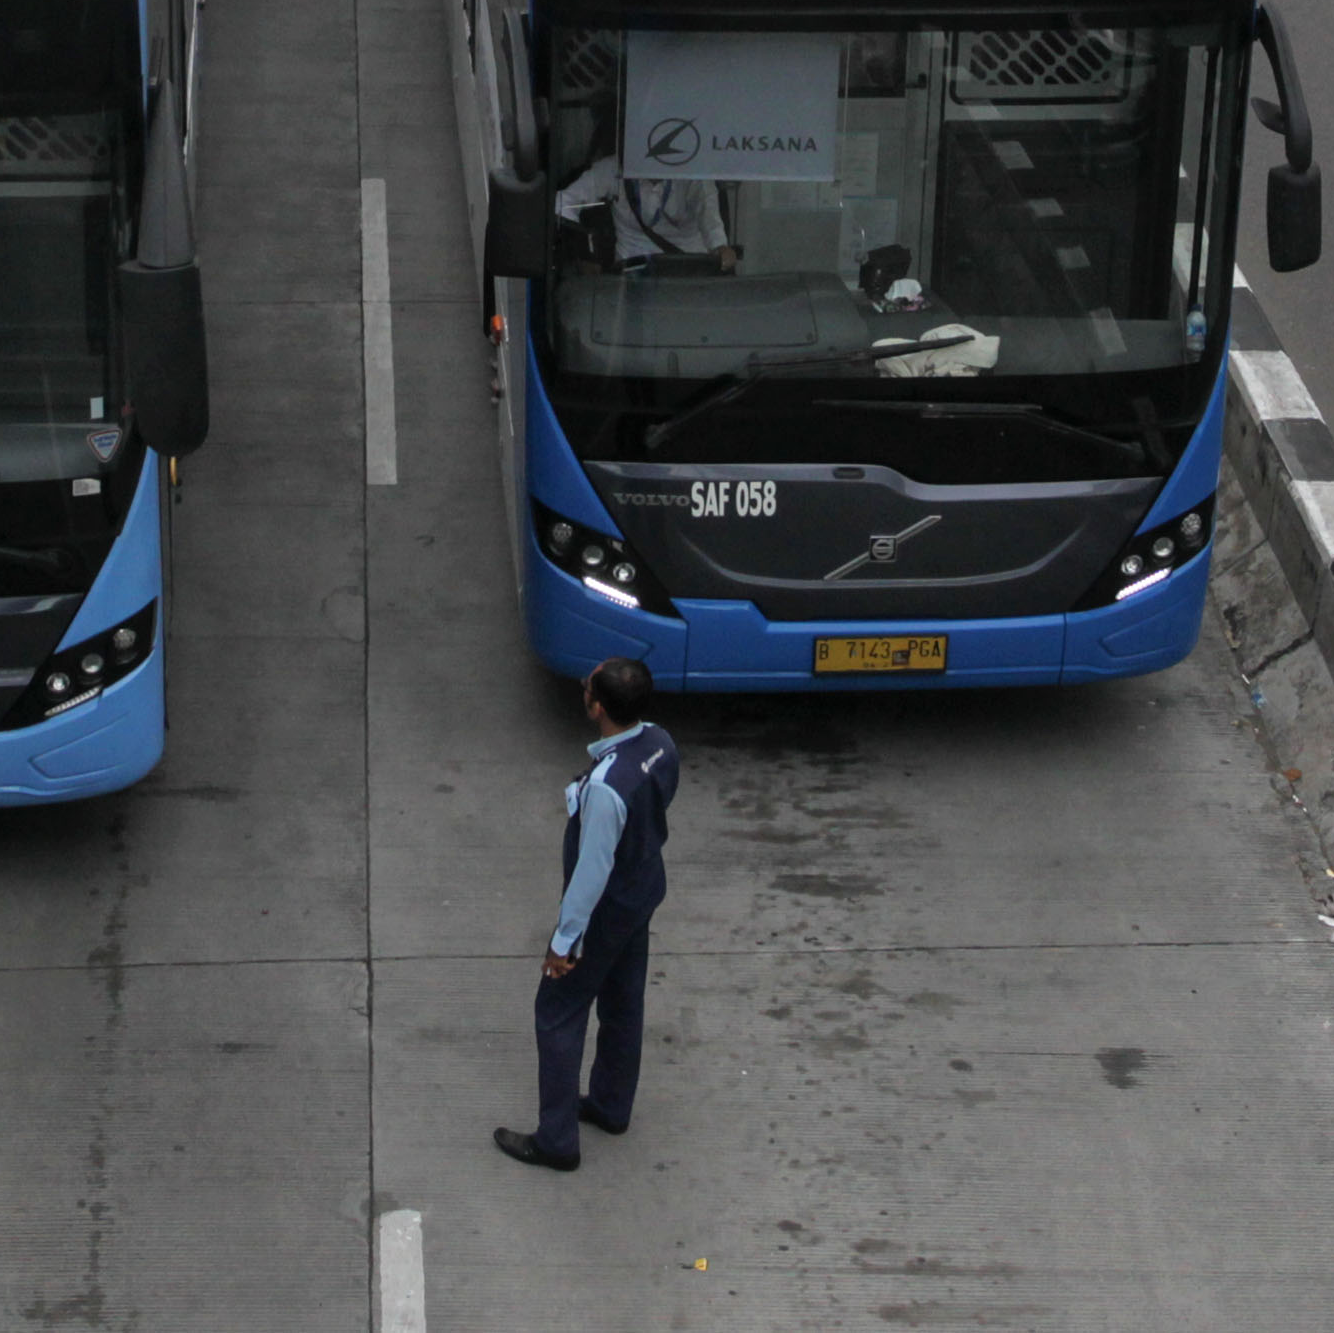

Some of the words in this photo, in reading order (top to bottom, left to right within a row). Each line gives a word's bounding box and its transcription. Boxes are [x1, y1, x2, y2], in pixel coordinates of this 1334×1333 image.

[712, 135, 817, 152] LAKSANA
[613, 492, 690, 507] VOLVO
[691, 481, 730, 517] SAF
[735, 480, 776, 517] 058
[818, 642, 830, 660] B
[845, 641, 891, 659] 7143
[908, 639, 941, 658] PGA
